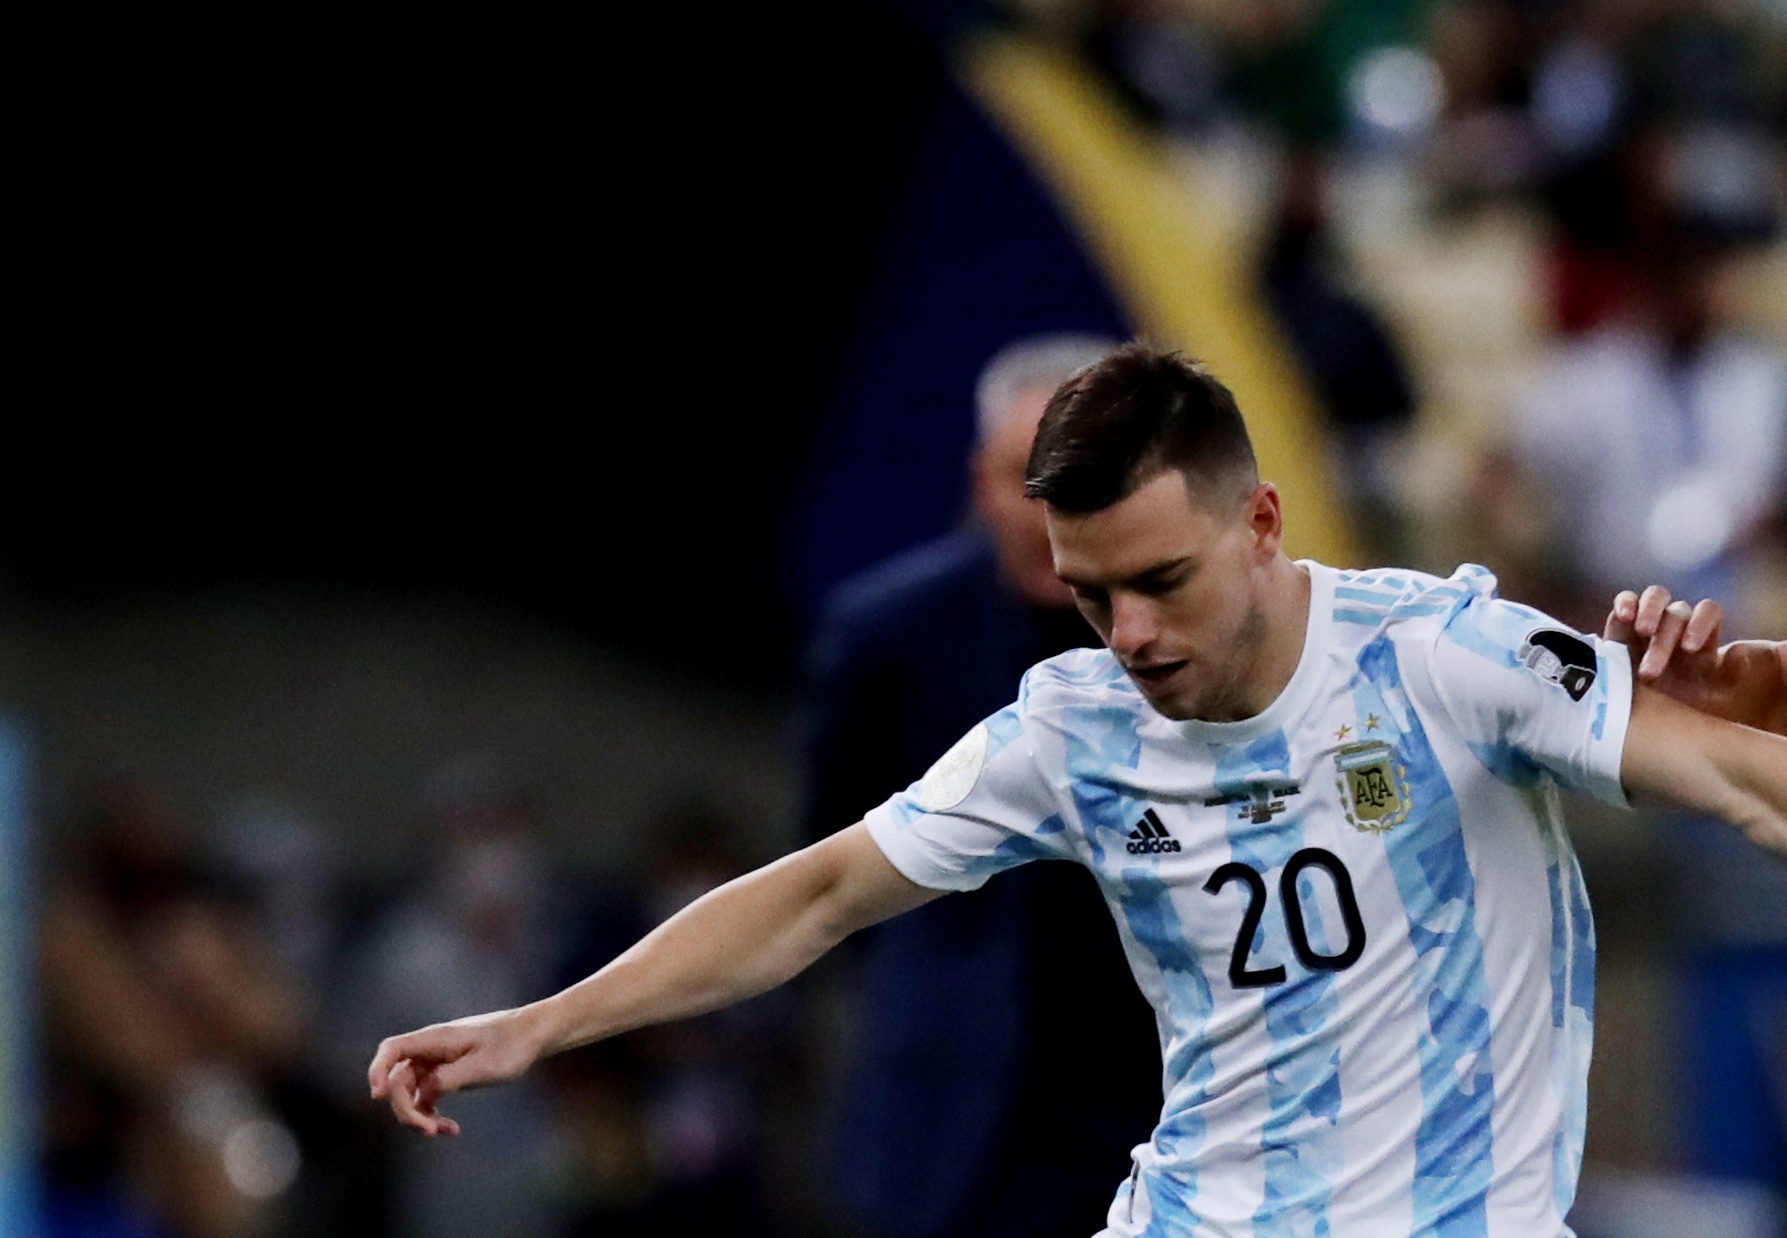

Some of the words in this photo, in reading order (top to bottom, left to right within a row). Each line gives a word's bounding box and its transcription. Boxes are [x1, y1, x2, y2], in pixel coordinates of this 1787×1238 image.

[1354, 767, 1393, 808] AFA
[1126, 837, 1182, 855] adidas
[1201, 846, 1367, 990] 20
